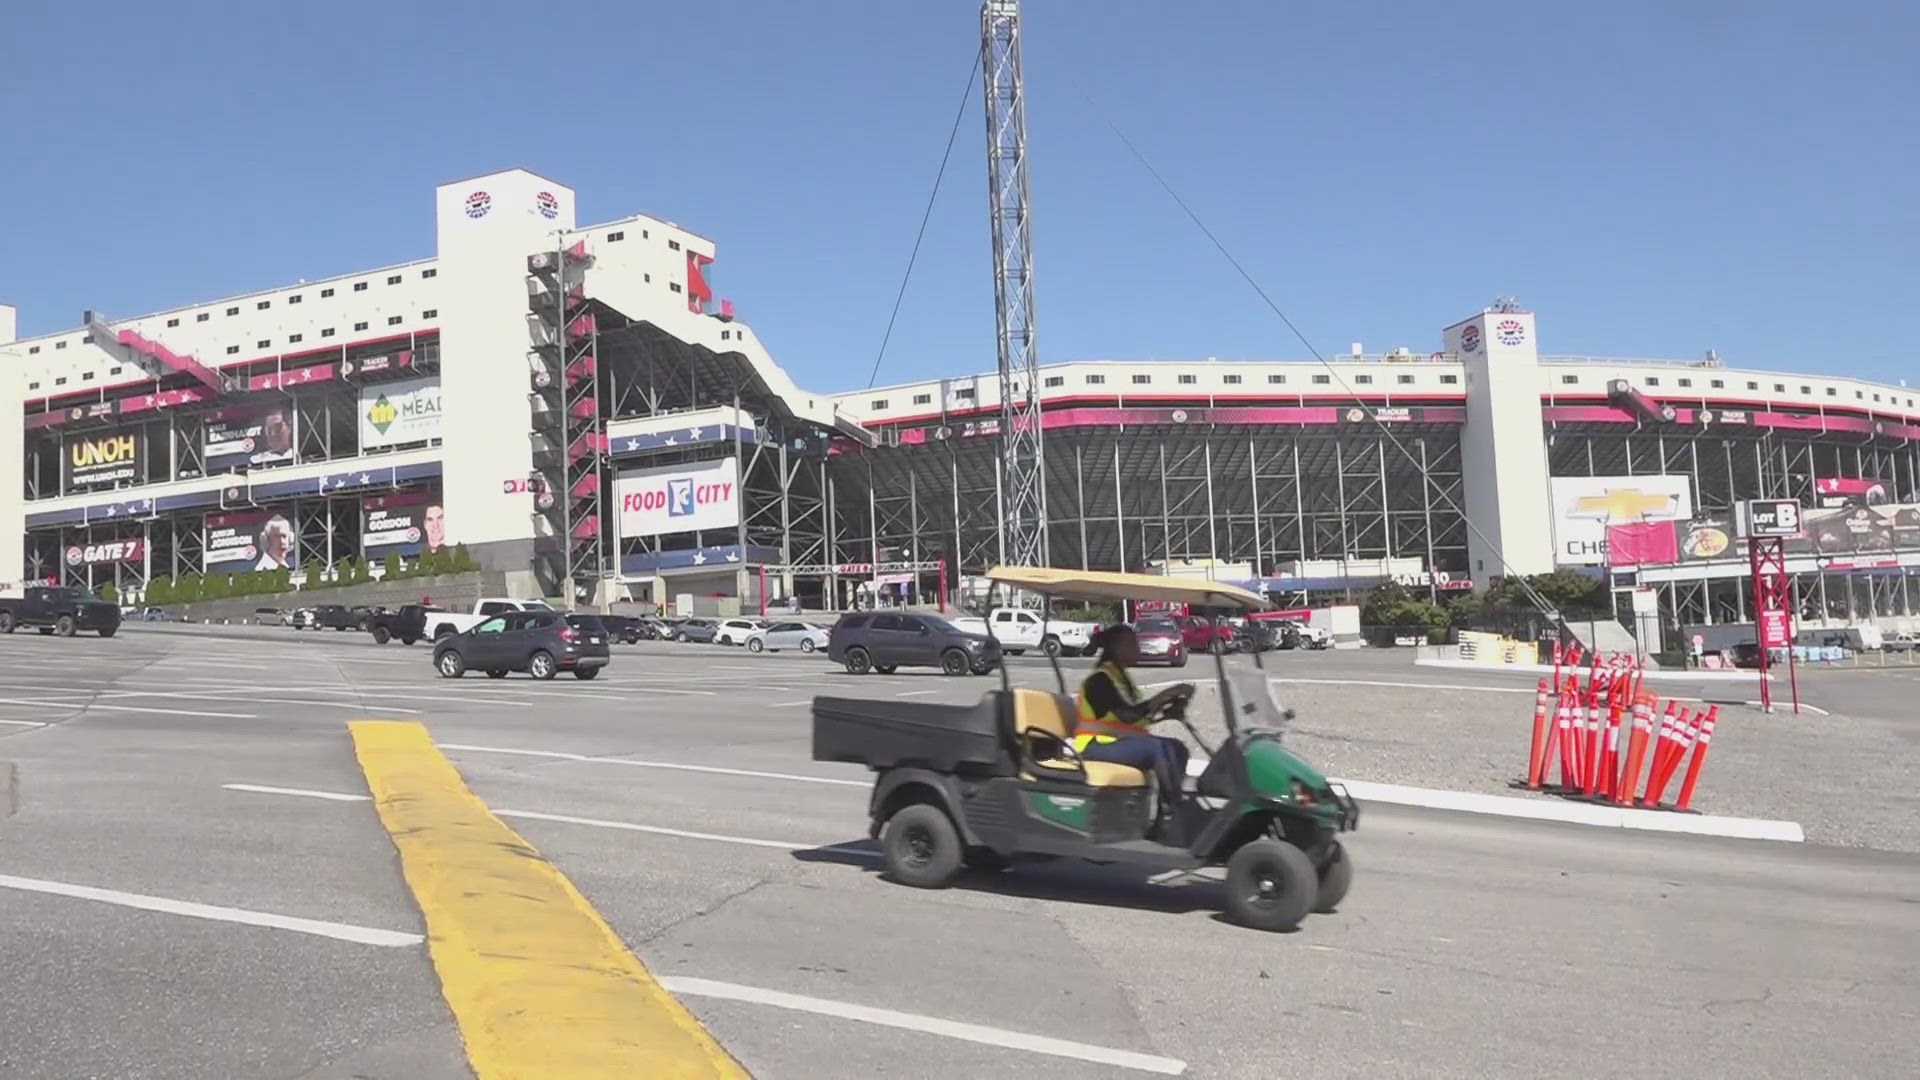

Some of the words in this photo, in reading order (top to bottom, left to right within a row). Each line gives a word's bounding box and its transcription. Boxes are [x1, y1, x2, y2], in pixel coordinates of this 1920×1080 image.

[73, 435, 134, 467] UNOH
[624, 490, 665, 512] FOOD
[696, 483, 732, 504] CITY
[369, 517, 411, 532] GORDON
[1753, 513, 1775, 523] LOT
[1776, 503, 1798, 527] B
[83, 543, 124, 562] GATE
[124, 541, 136, 558] 7
[1433, 571, 1449, 585] 10
